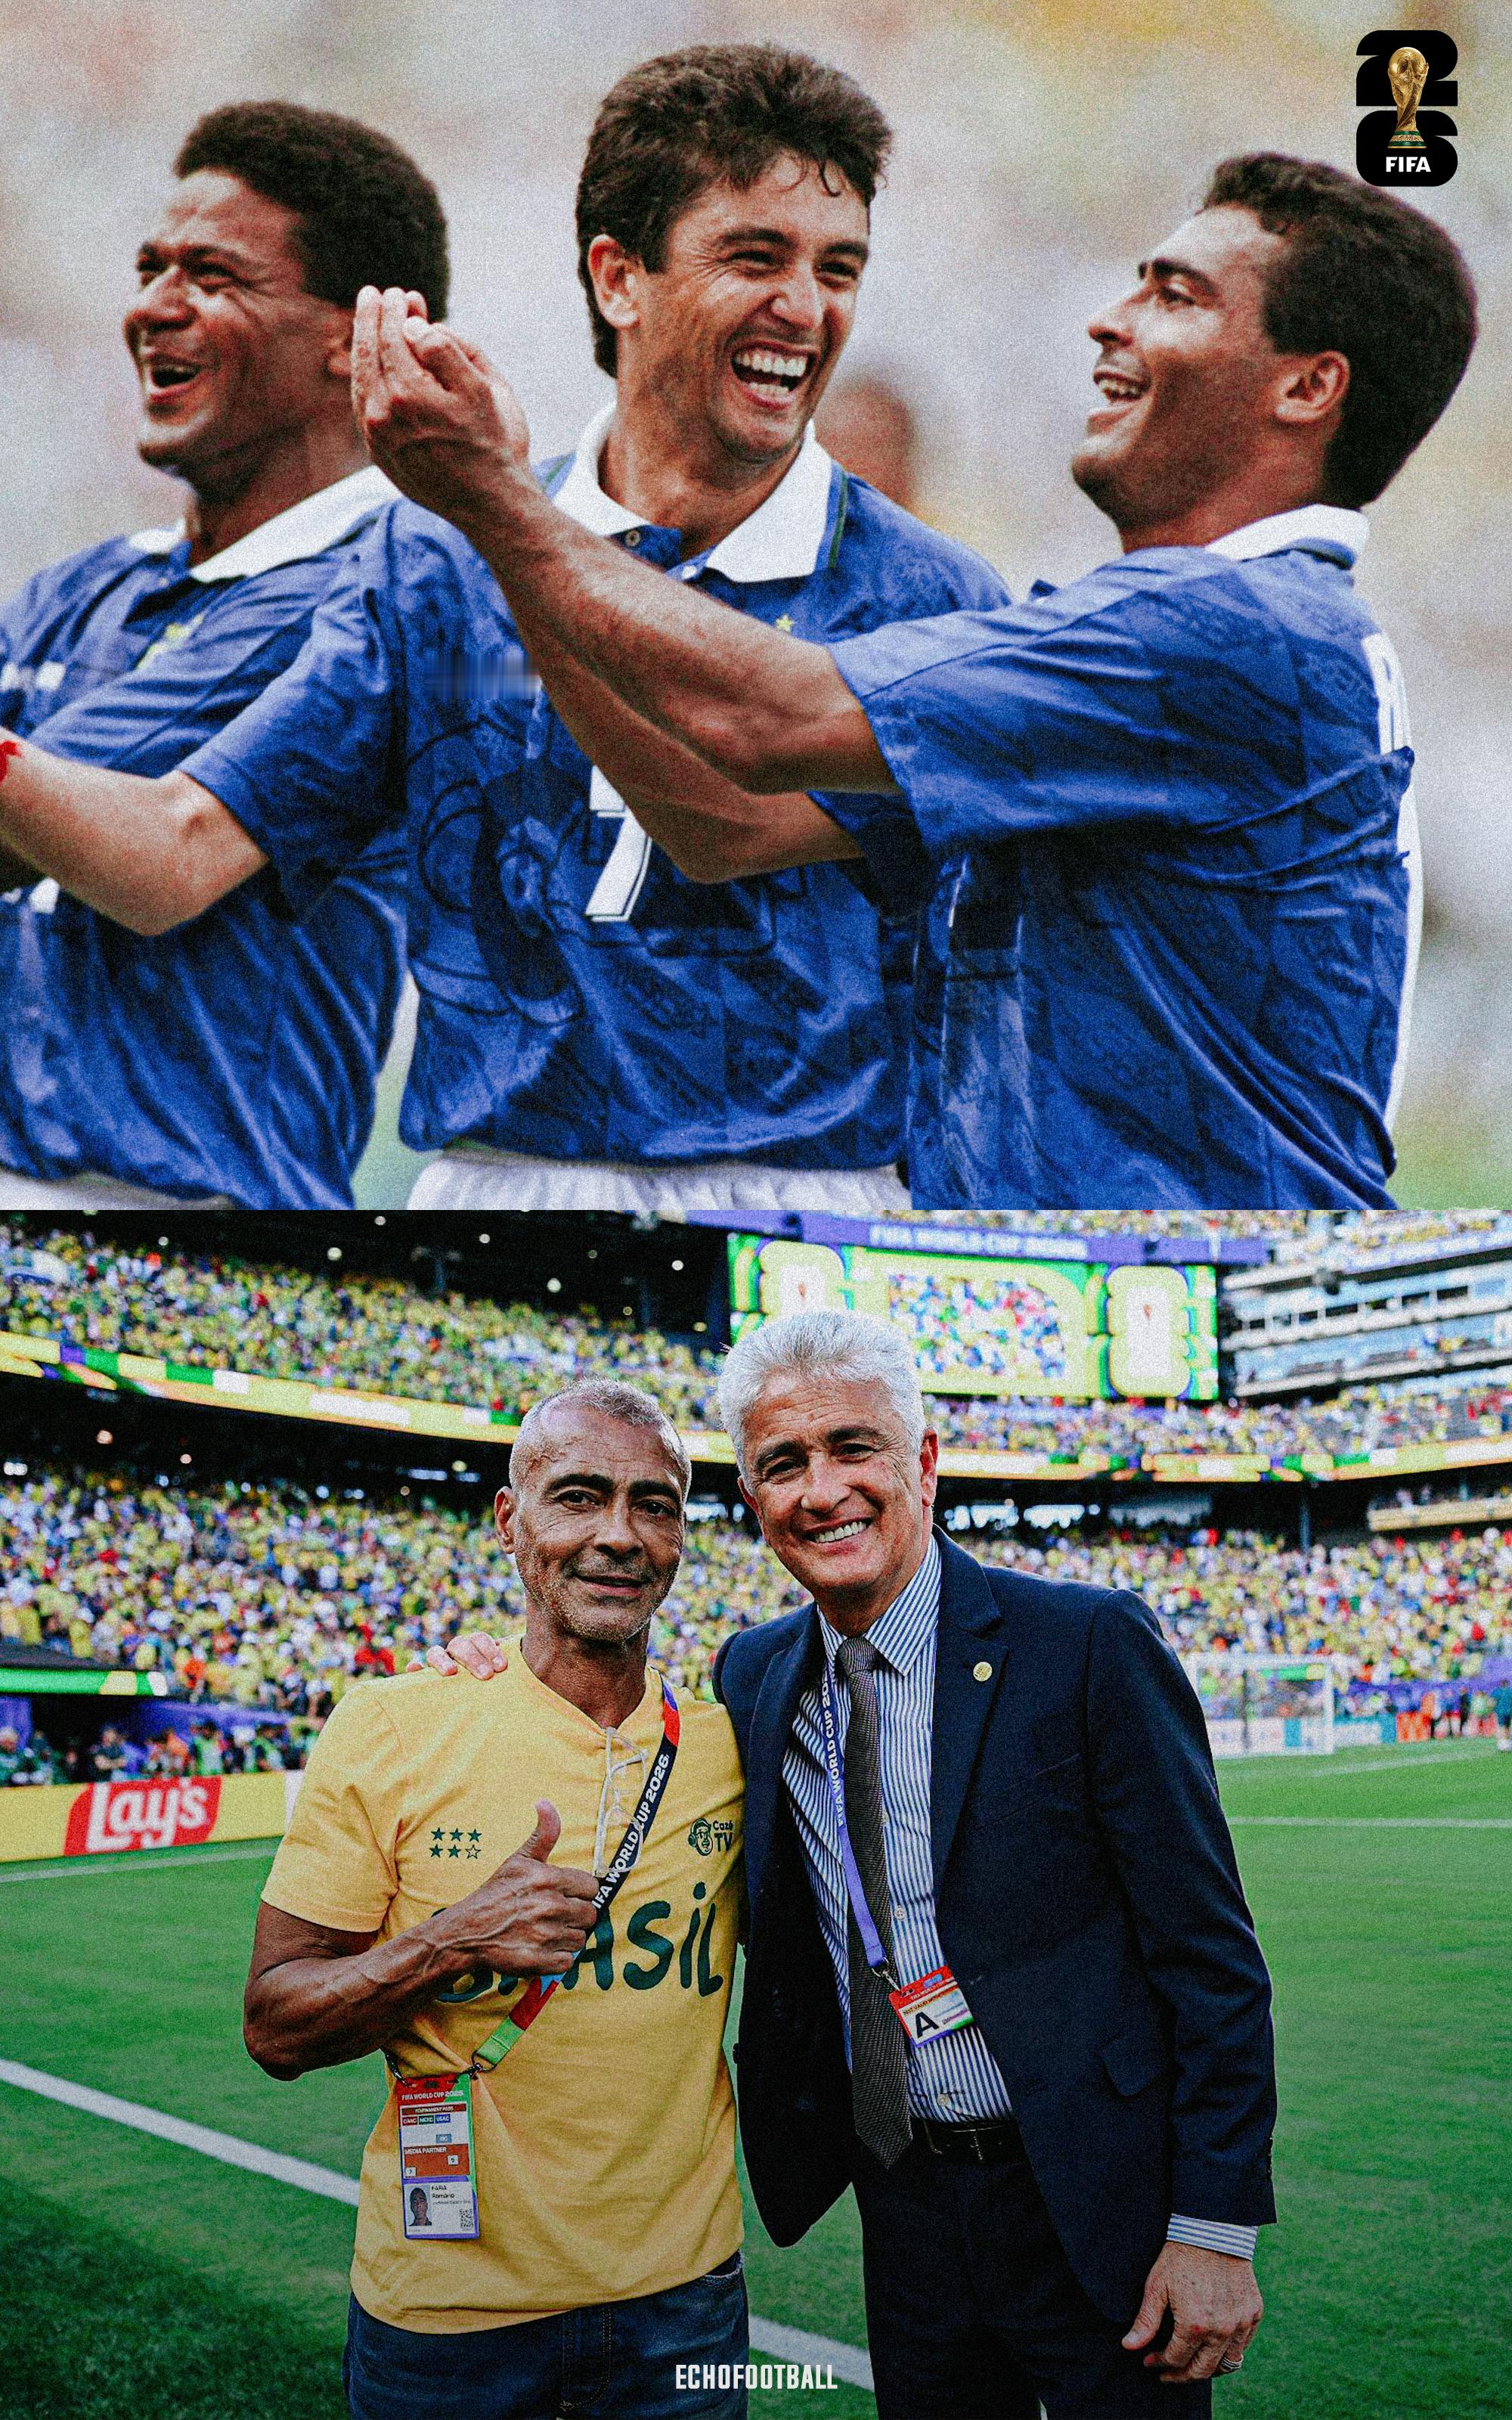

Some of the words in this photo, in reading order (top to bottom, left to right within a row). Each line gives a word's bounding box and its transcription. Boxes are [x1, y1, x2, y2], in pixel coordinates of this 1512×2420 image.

[824, 1709, 834, 1737] CUP
[828, 1739, 843, 1793] WORLD
[85, 1777, 209, 1852] Lay's
[714, 1832, 733, 1852] TV
[591, 1885, 612, 1909] IFA
[606, 1830, 639, 1884] WORLD
[915, 2011, 940, 2038] A
